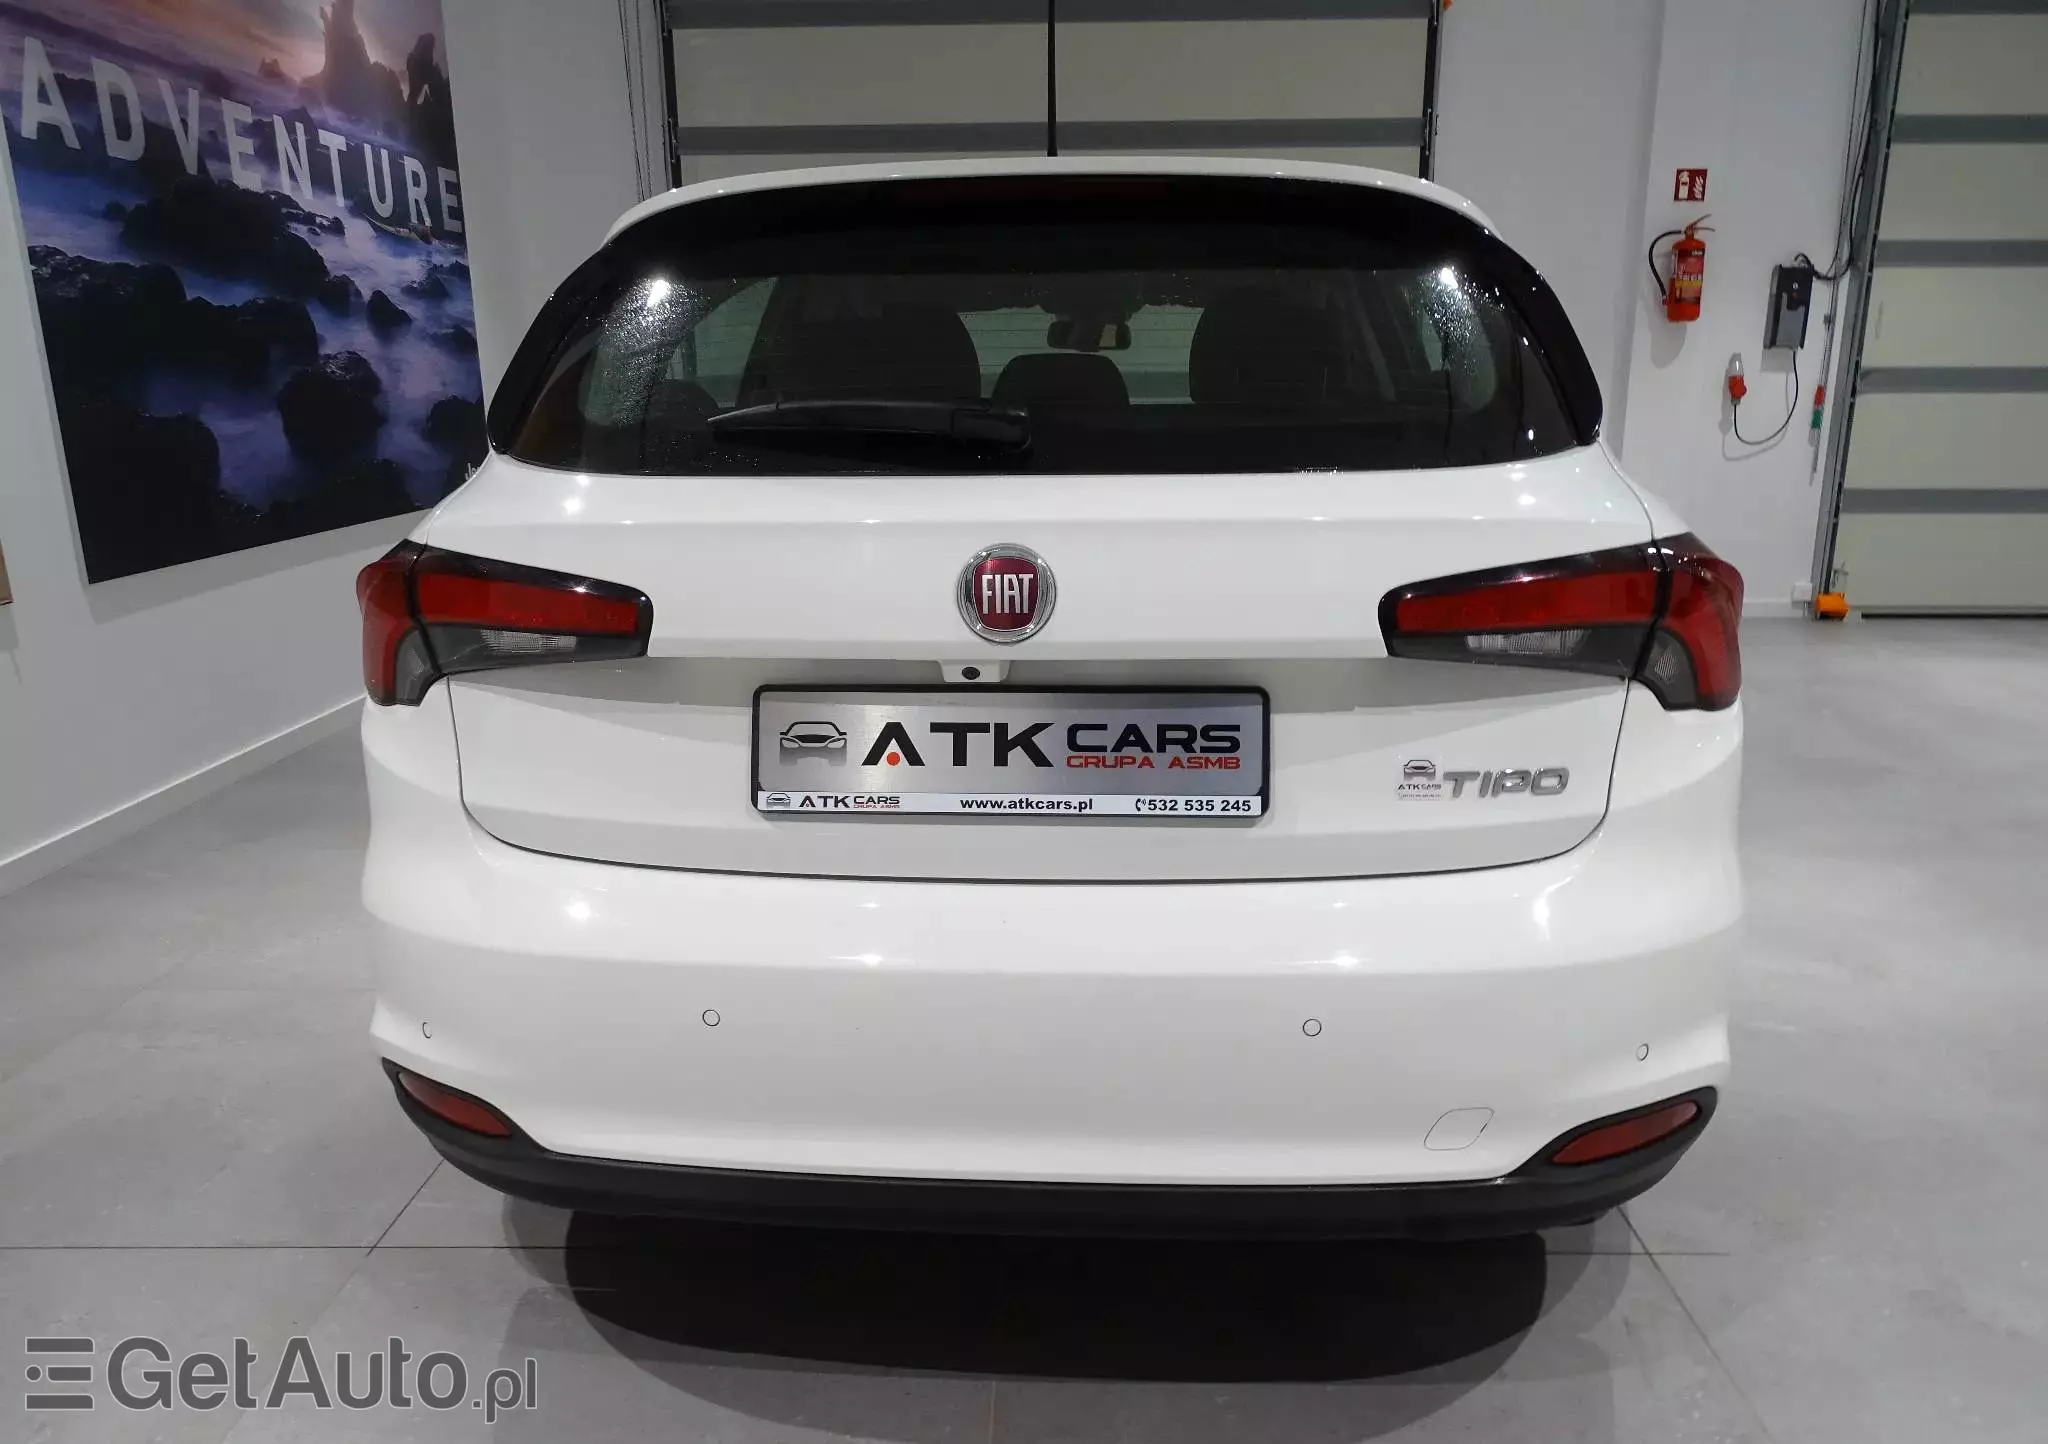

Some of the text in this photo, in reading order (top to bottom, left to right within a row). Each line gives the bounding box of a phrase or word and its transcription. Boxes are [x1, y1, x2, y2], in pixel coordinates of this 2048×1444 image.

[20, 36, 462, 233] ADVENTURE
[981, 573, 1034, 614] FIAT
[861, 721, 1241, 767] ATK CARS
[1066, 755, 1241, 770] GRUPA ASMB
[1442, 767, 1570, 799] TIPO
[799, 795, 900, 808] ATK CARS
[960, 798, 1093, 812] www.atkcars.pl
[1147, 799, 1252, 812] 532 535 245
